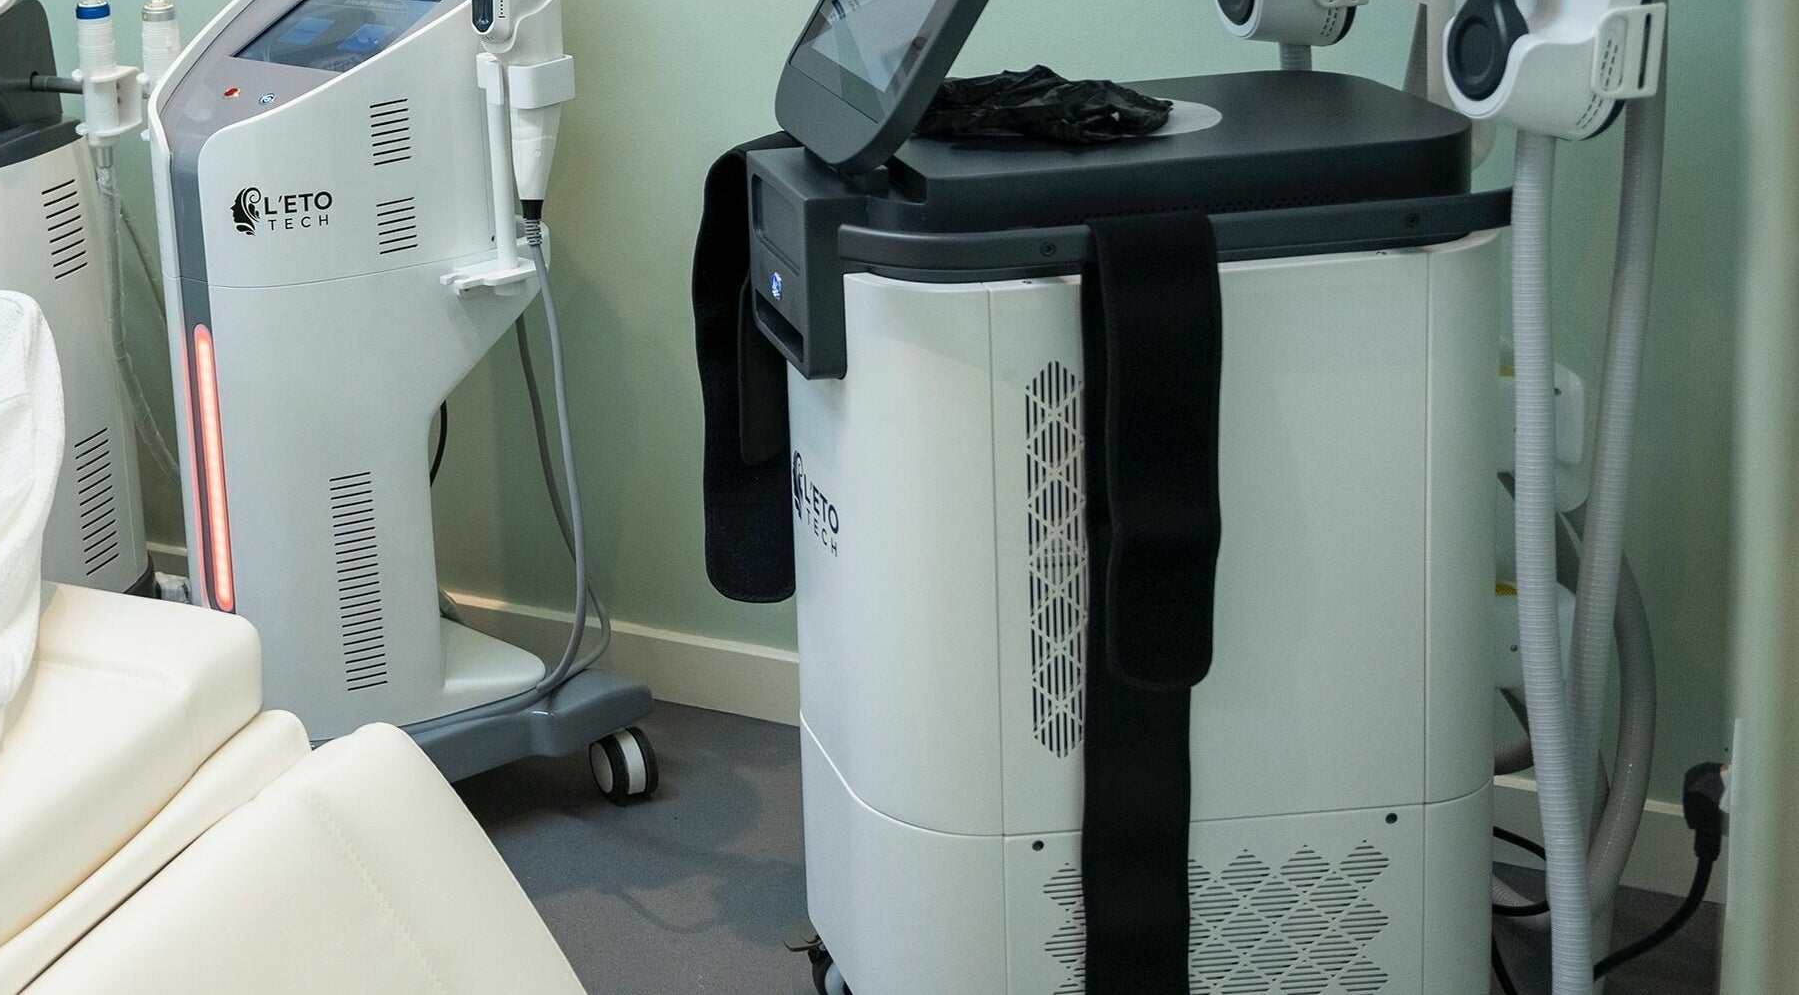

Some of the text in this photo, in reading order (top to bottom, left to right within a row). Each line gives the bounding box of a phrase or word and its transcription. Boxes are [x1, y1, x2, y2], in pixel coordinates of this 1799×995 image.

[264, 191, 332, 215] L'ETO
[268, 214, 329, 231] TECH
[804, 473, 839, 534] L'ETO
[806, 507, 838, 557] TECH
